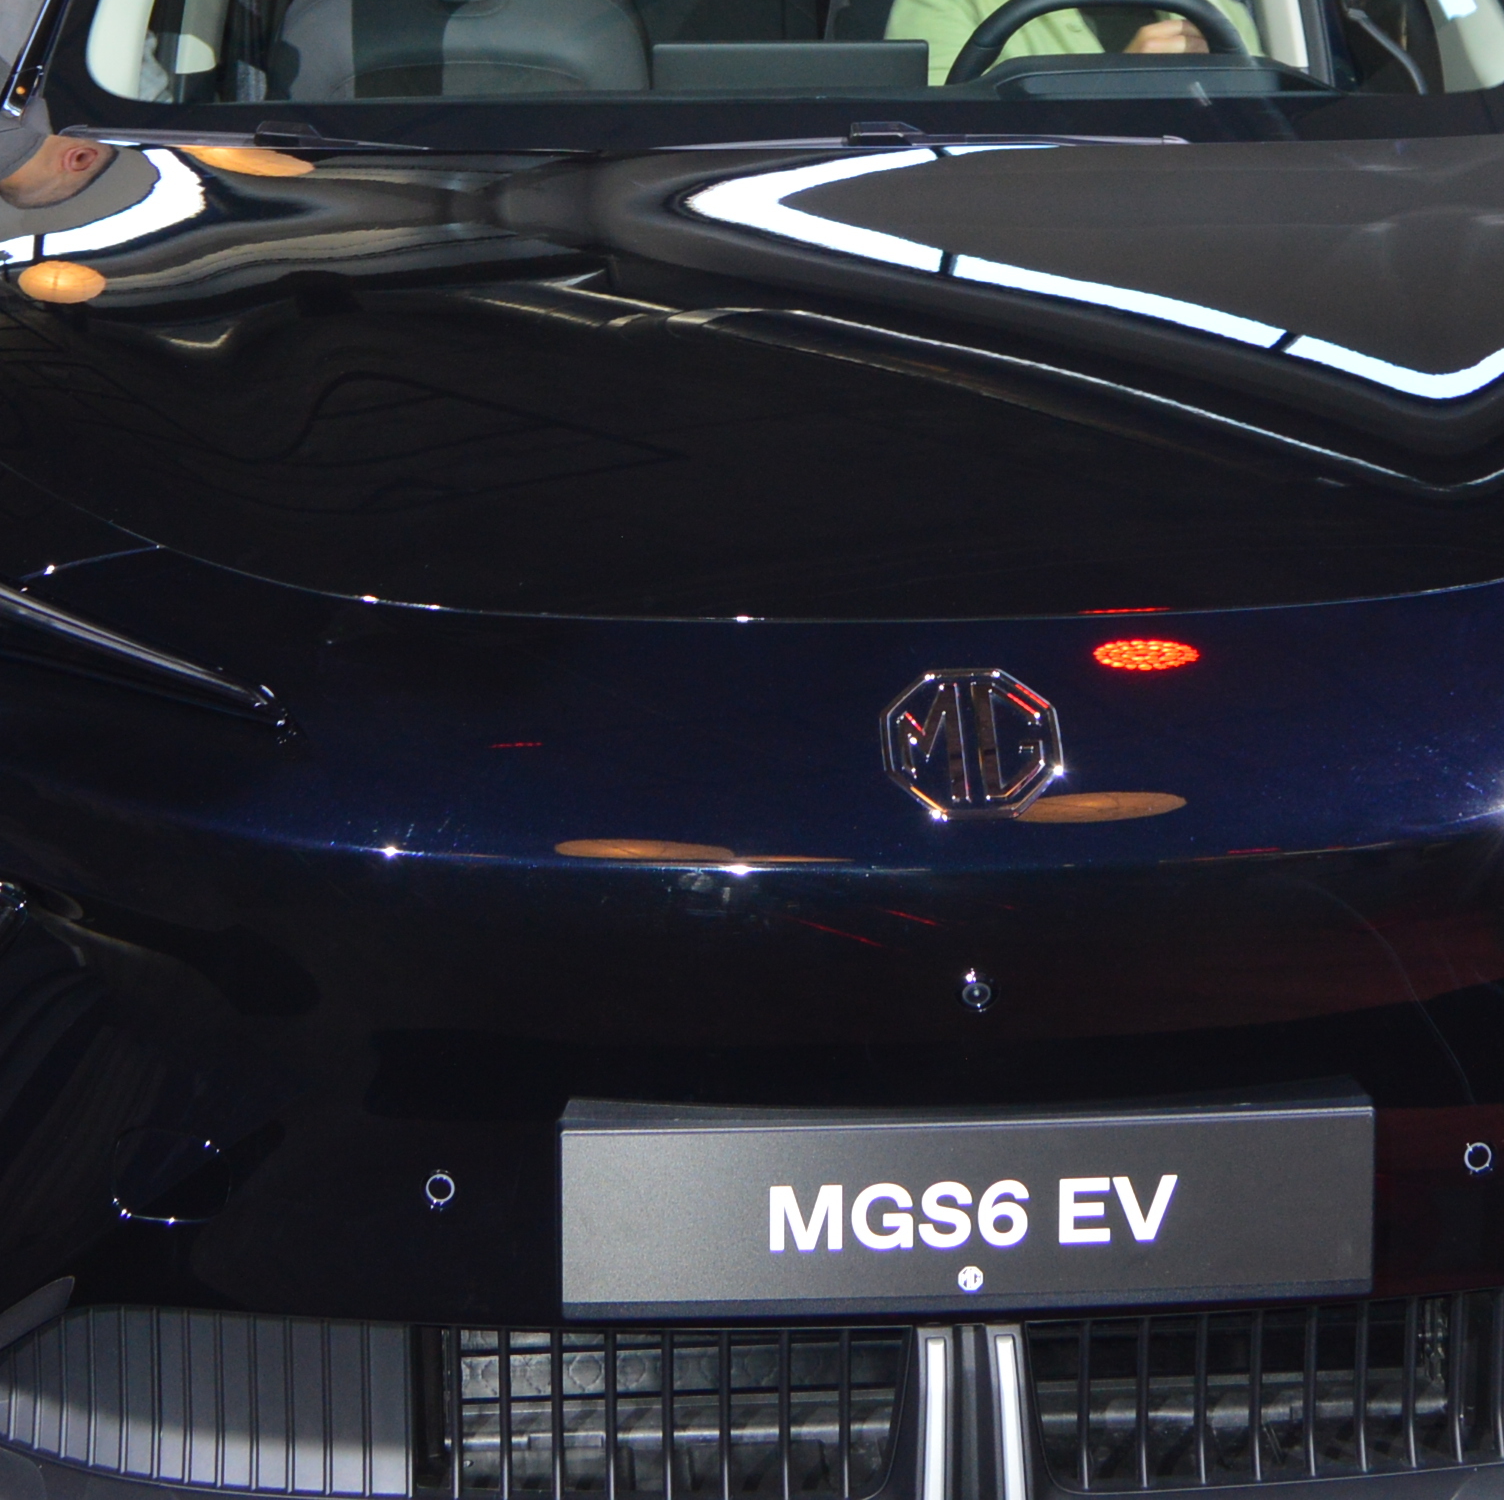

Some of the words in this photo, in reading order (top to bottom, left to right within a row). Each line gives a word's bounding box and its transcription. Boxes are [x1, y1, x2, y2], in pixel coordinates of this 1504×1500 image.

[886, 673, 1059, 815] MG
[769, 1179, 1030, 1251] MGS6
[1059, 1174, 1178, 1244] EV
[958, 1265, 984, 1291] MG
